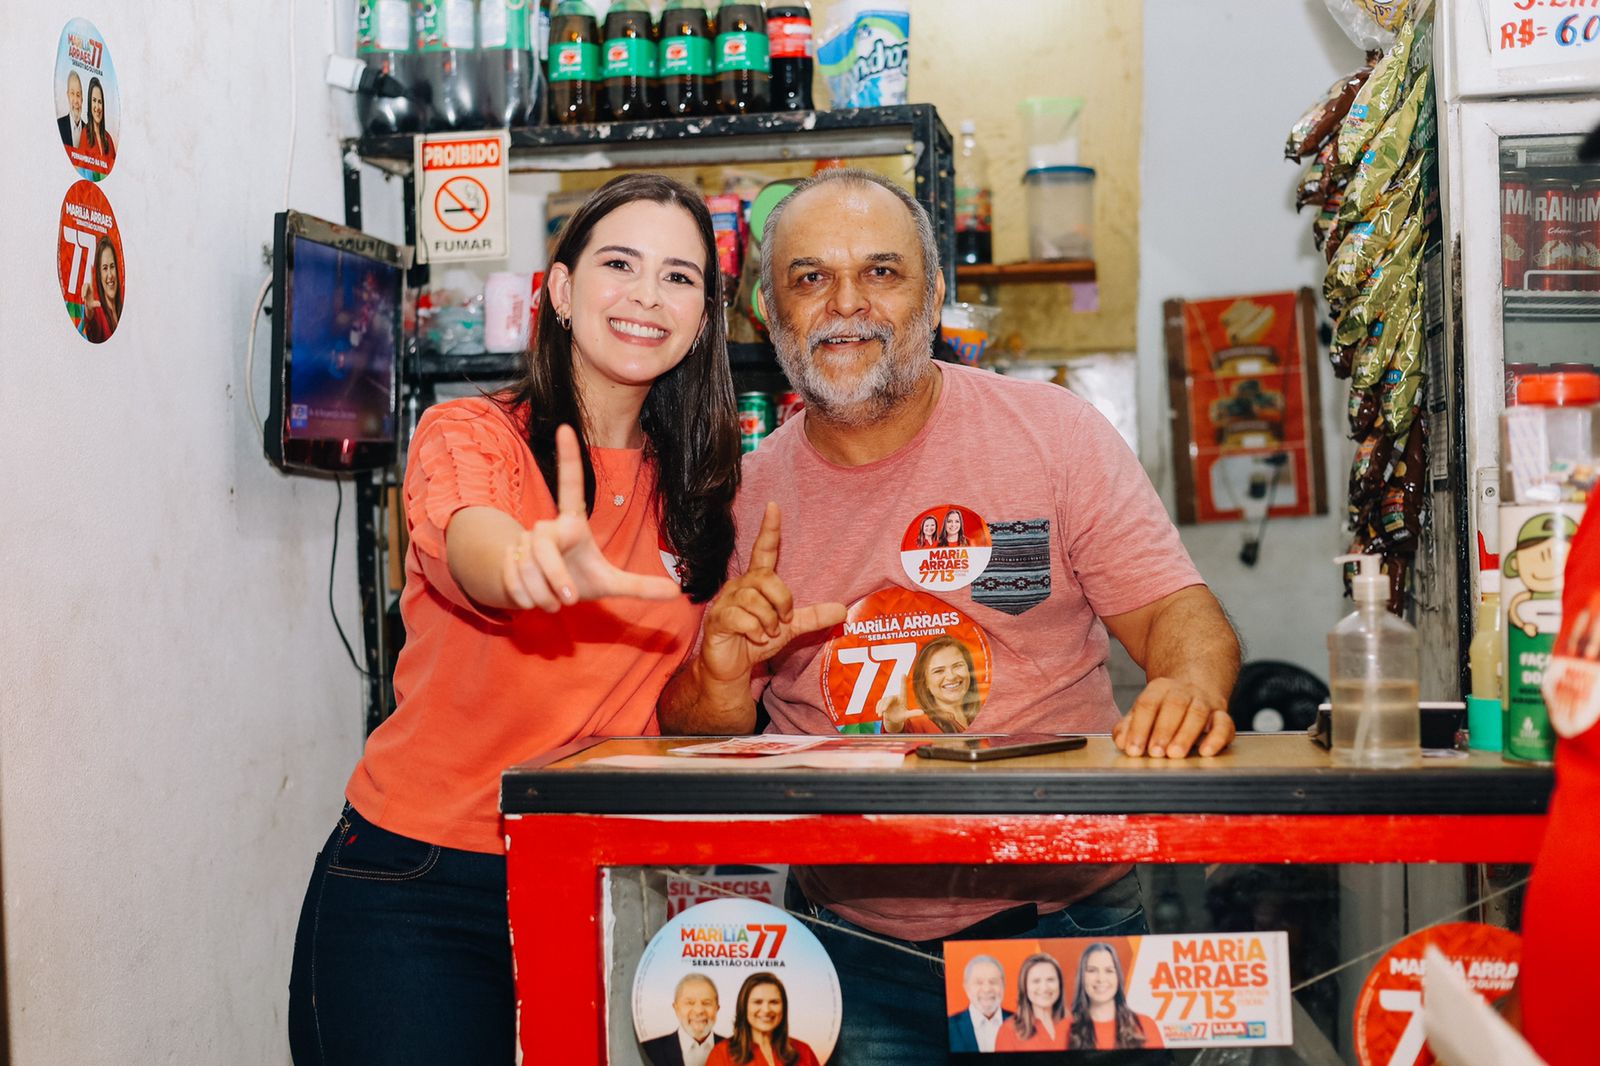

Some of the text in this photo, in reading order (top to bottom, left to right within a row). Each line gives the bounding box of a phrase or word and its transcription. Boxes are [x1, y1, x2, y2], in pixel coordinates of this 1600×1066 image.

[423, 142, 499, 167] PROIBIDO
[90, 210, 112, 229] ARRAES
[434, 239, 493, 252] FUMAR
[63, 225, 97, 295] 77
[919, 559, 969, 571] ARRAES
[920, 570, 955, 584] 7713
[903, 612, 960, 630] ARRAES
[910, 627, 946, 638] OLIVEIRA
[837, 642, 917, 716] 77
[698, 881, 771, 897] PRECISA
[746, 923, 788, 959] 77
[681, 943, 749, 958] ARRAES
[743, 959, 786, 968] OLIVEIRA
[1149, 962, 1269, 989] ARRAES
[1151, 989, 1238, 1022] 7713
